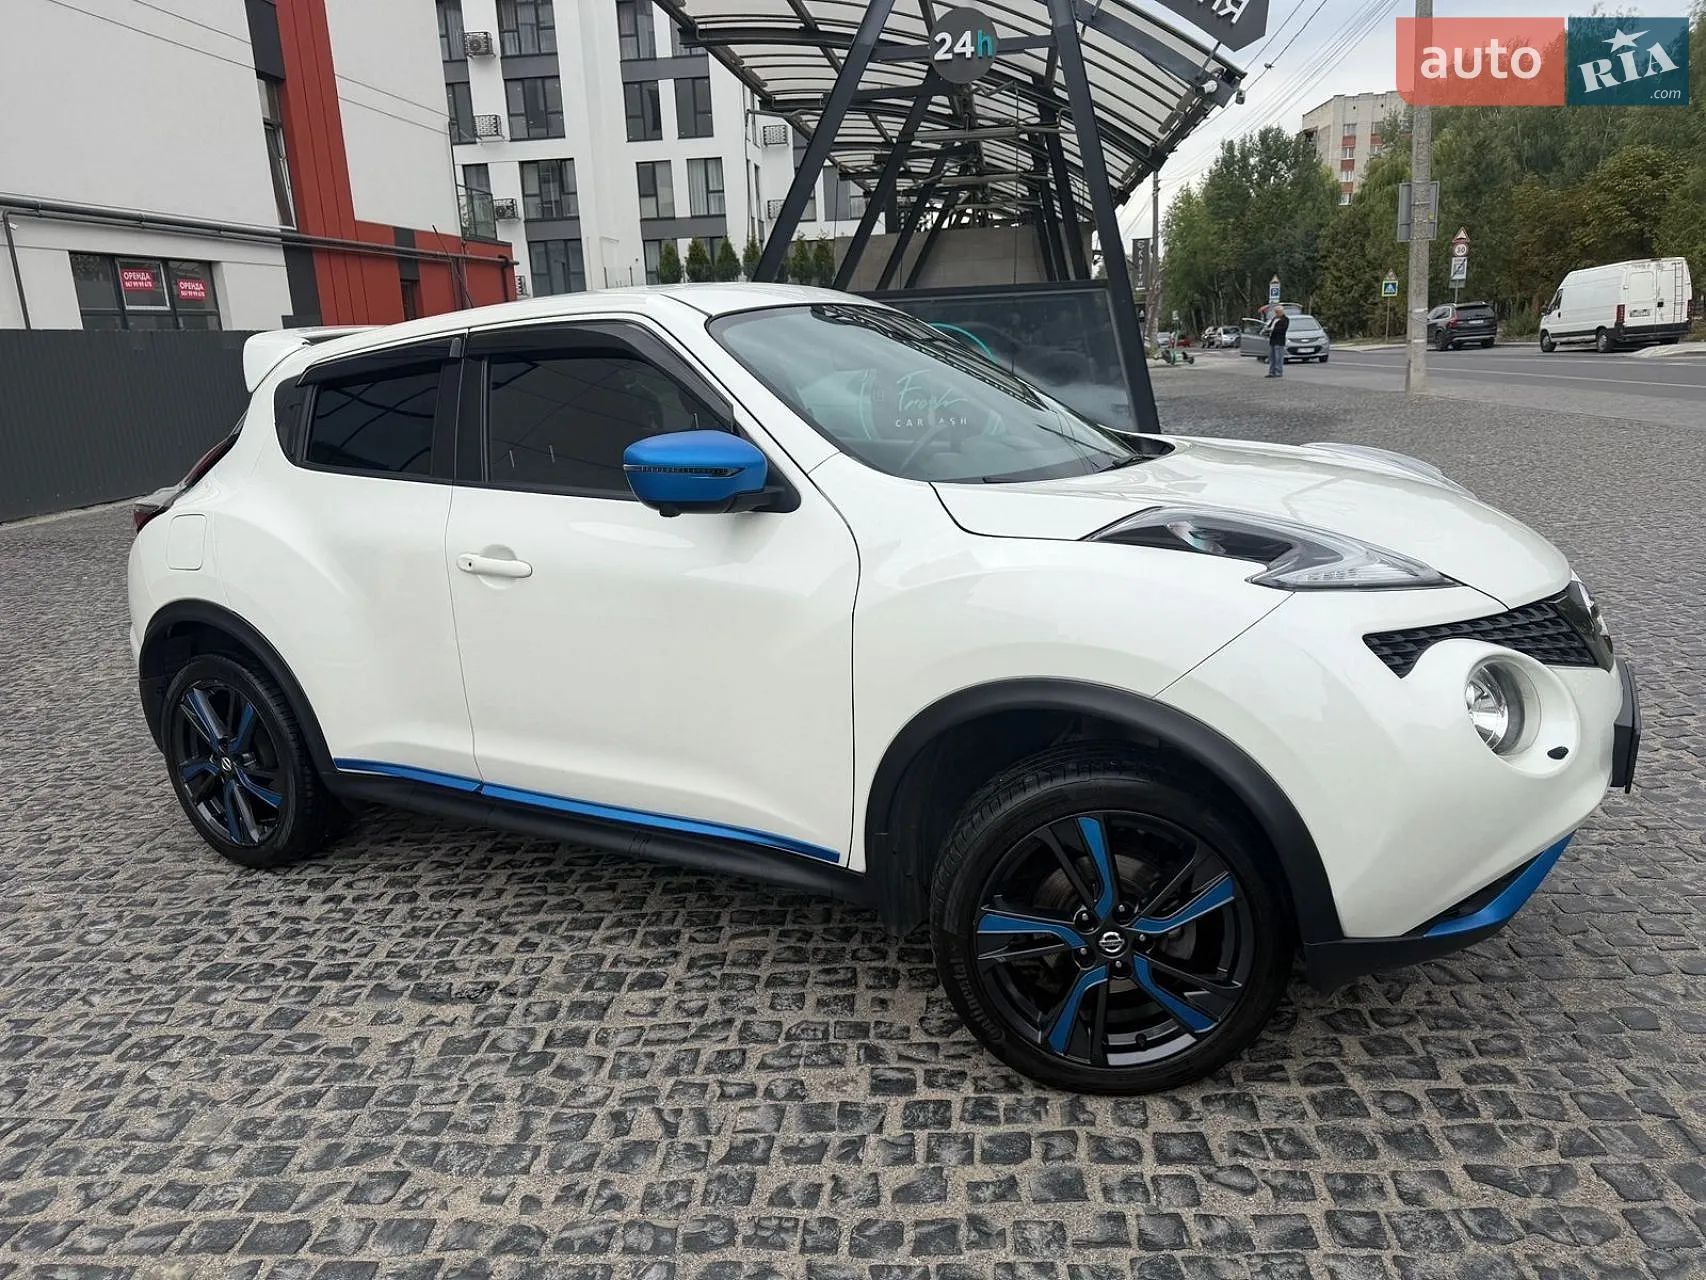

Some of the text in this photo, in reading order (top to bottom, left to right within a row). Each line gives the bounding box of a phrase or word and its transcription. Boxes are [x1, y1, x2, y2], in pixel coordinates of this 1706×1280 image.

[934, 29, 993, 60] 24h
[123, 271, 151, 281] ОРЕНДА
[179, 281, 204, 291] ОРЕНДА
